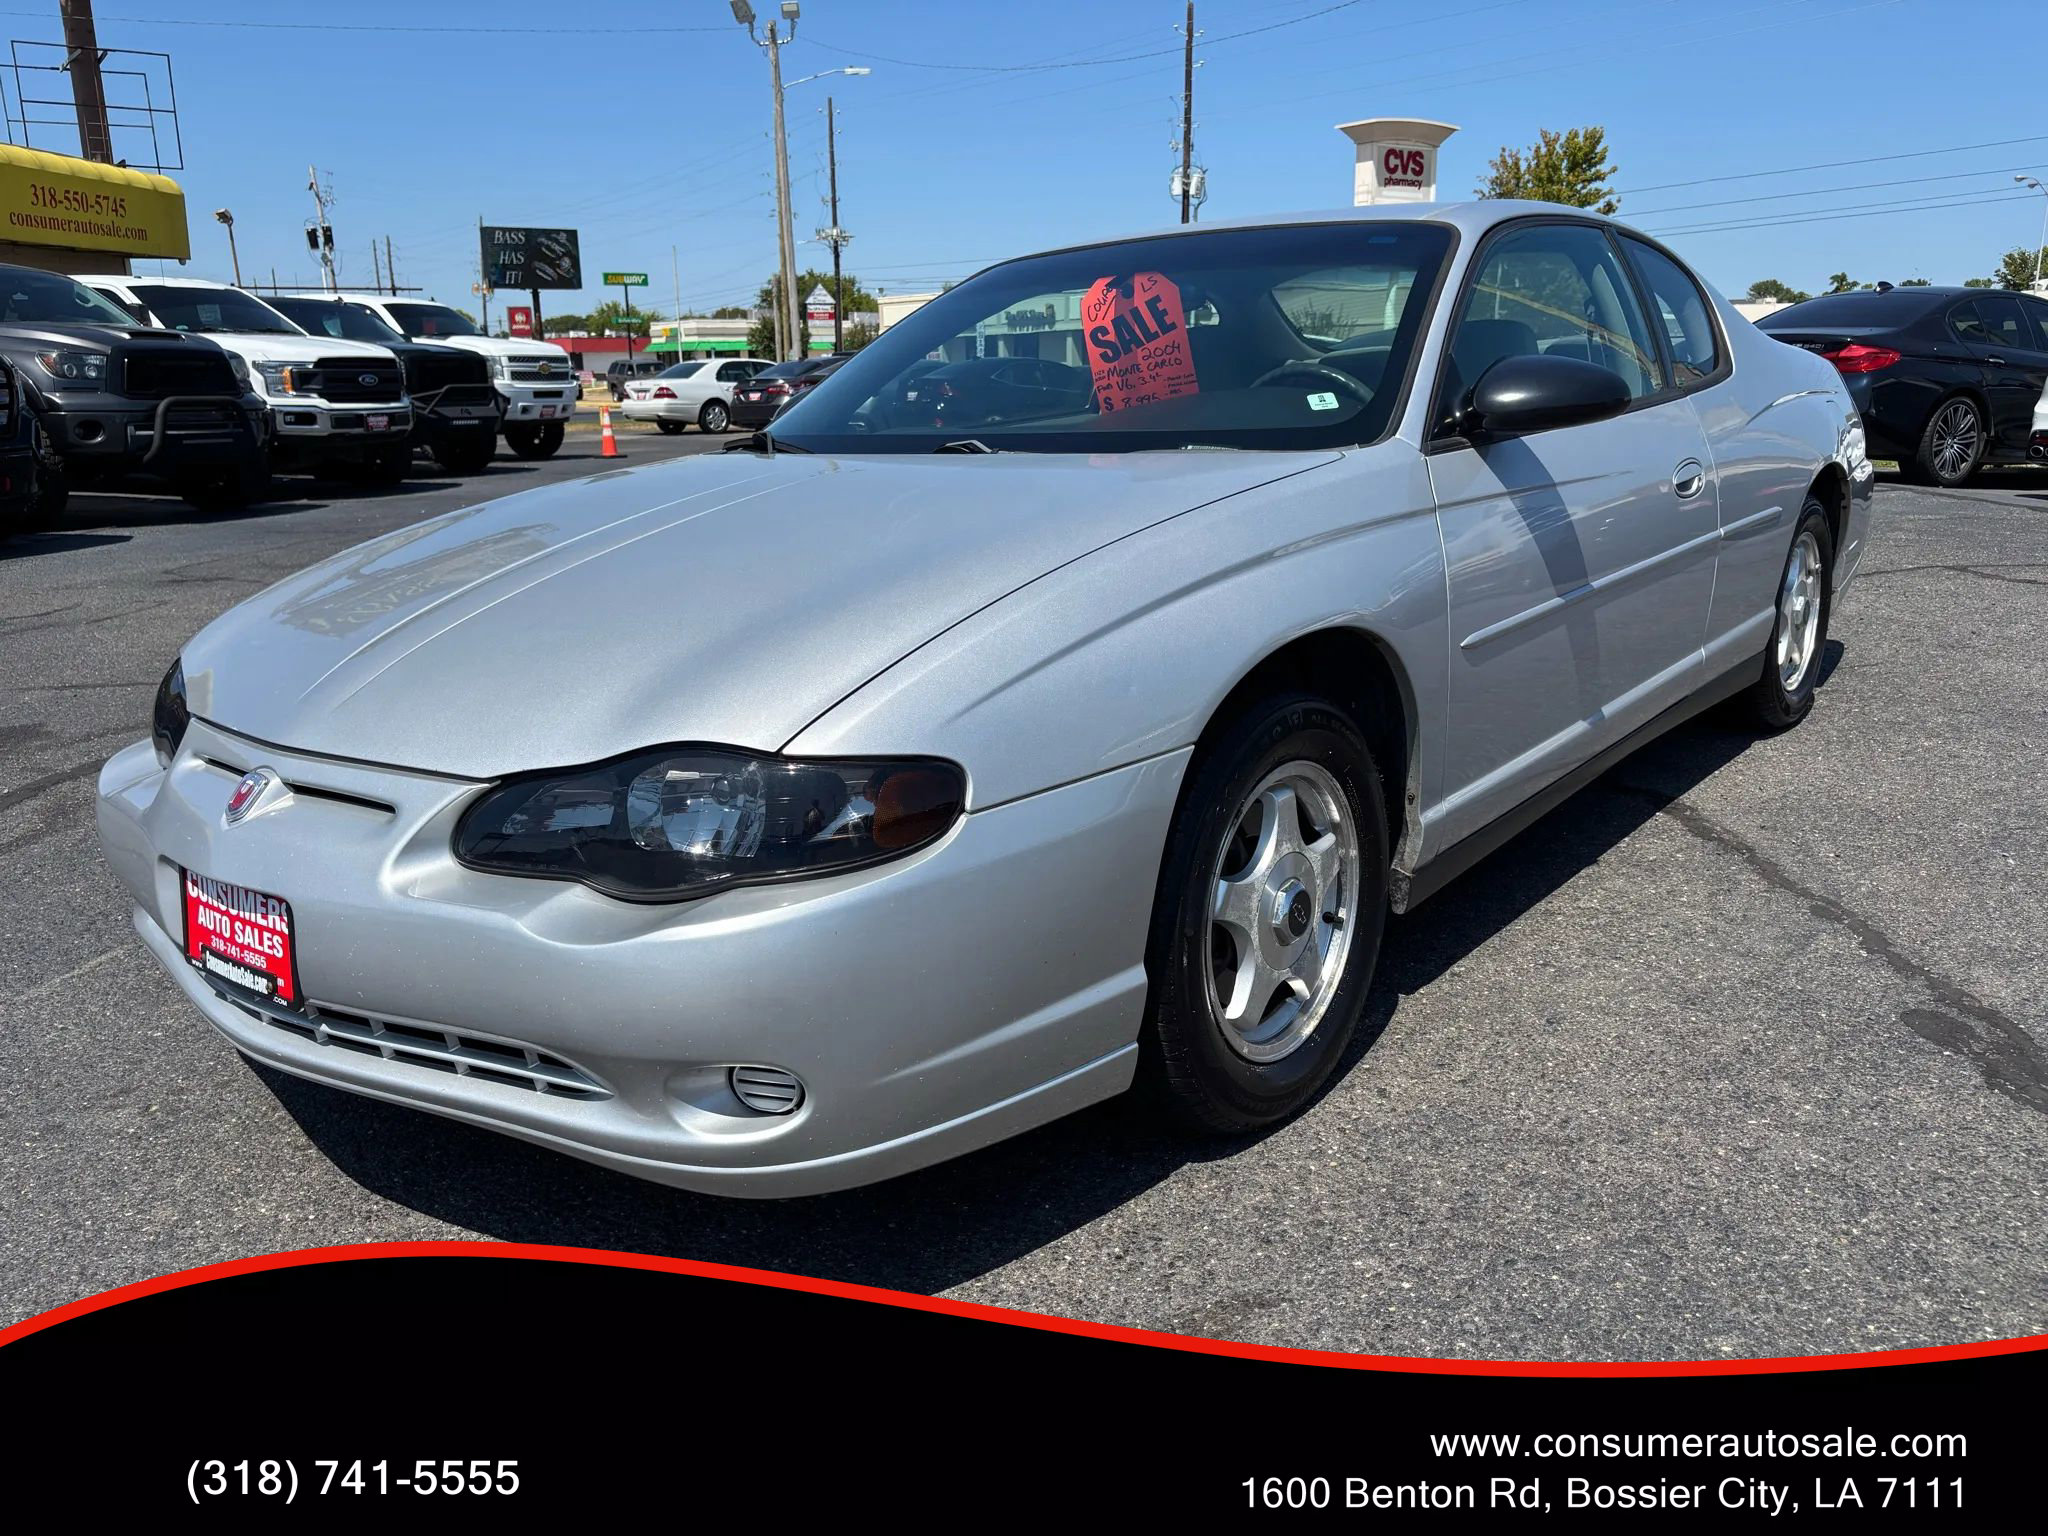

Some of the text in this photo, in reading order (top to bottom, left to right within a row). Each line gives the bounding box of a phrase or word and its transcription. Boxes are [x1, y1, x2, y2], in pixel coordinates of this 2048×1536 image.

[1383, 148, 1425, 177] CVS
[1383, 176, 1424, 191] pharmacy
[29, 183, 128, 219] 318-550-5745
[9, 210, 149, 242] consumerautosale.com
[493, 230, 527, 246] BASS
[499, 249, 526, 266] HAS
[504, 271, 523, 285] IT!
[606, 275, 647, 285] SUBWAY
[1140, 275, 1159, 294] LS
[1088, 294, 1179, 364] SALE
[1141, 340, 1181, 362] 2004
[1106, 363, 1144, 381] MONTE
[1146, 358, 1183, 373] CARLO
[186, 869, 289, 935] CONSUMERS
[198, 904, 284, 959] AUTO SALES
[210, 934, 267, 969] 318-741-5555
